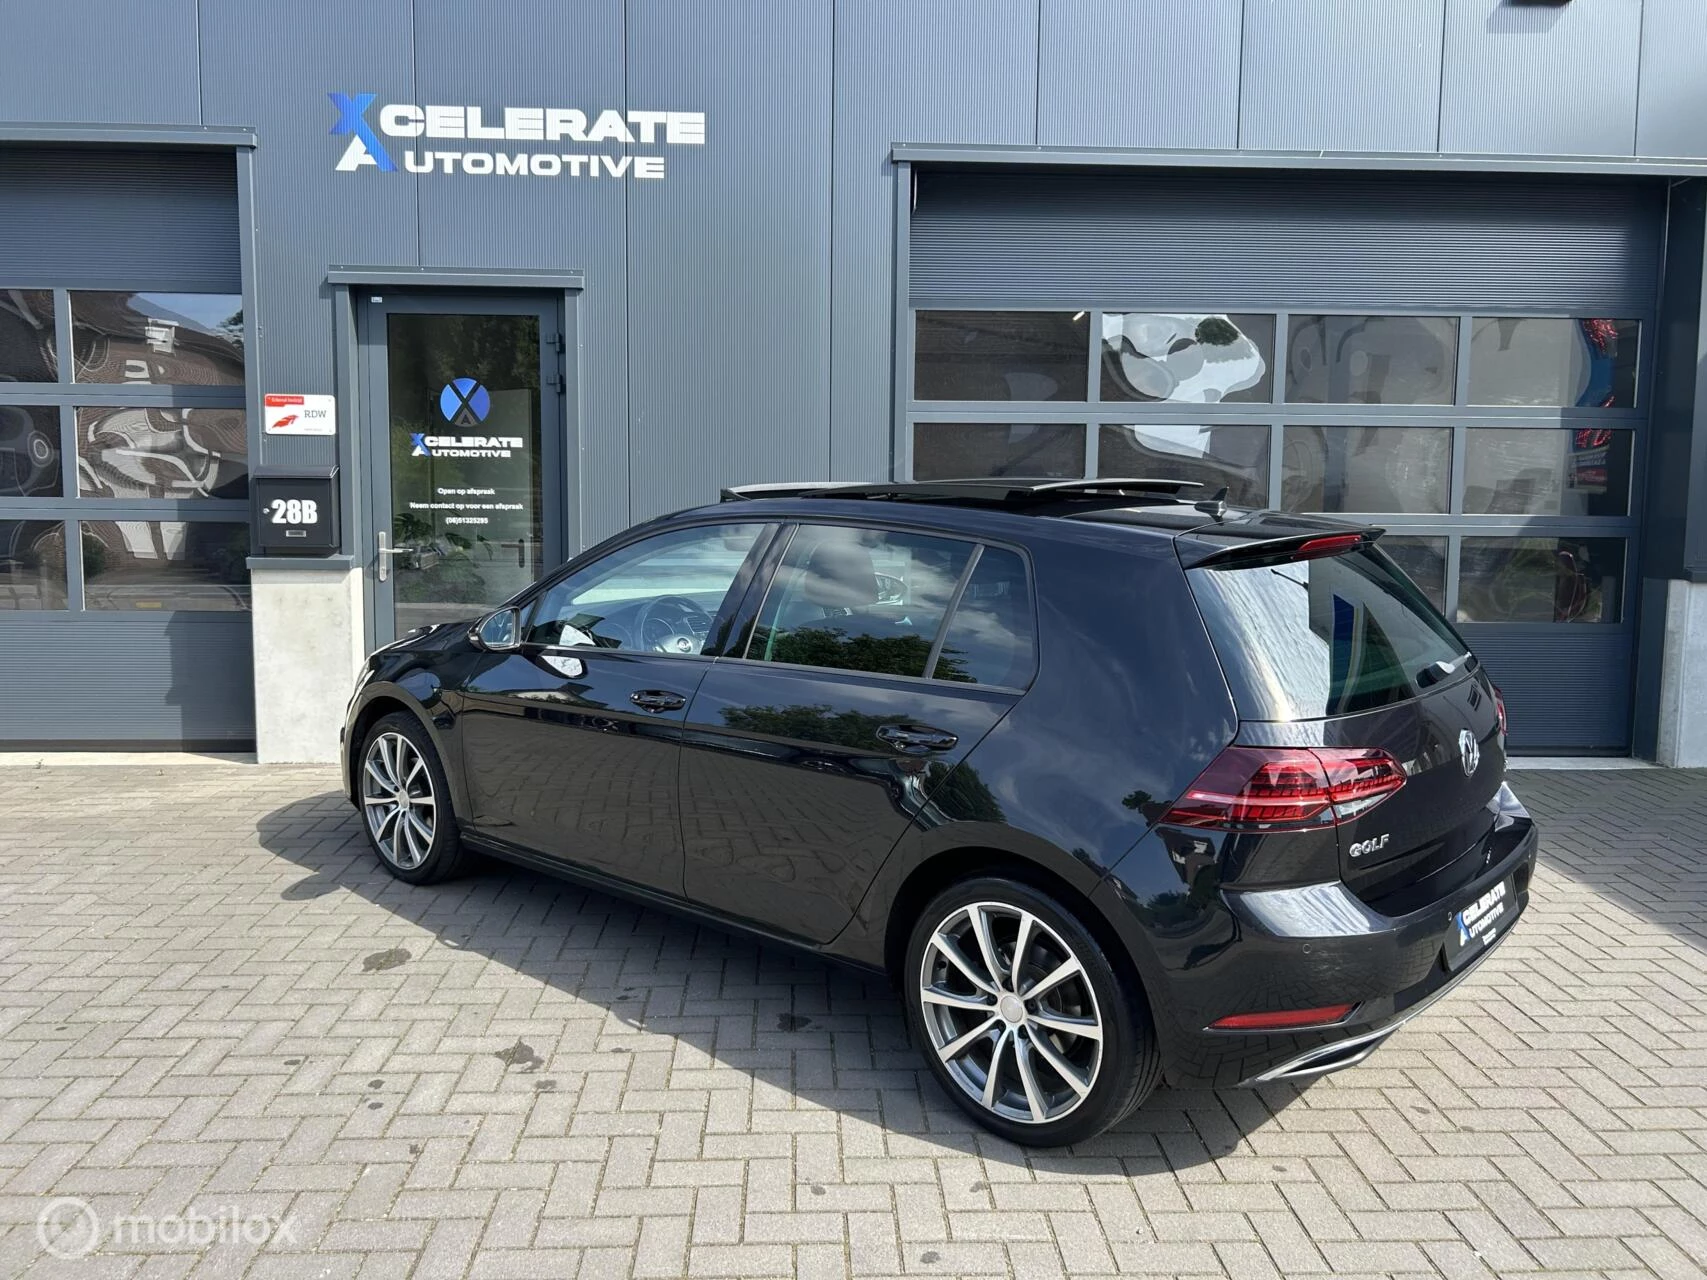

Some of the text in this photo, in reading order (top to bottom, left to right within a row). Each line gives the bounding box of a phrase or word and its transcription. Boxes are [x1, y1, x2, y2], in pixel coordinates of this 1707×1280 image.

[327, 93, 705, 146] XCELERATE
[304, 410, 327, 418] RDW
[467, 488, 495, 496] afspraak
[271, 499, 318, 524] 28B
[495, 503, 524, 511] afspraak
[1349, 833, 1390, 857] GOLF
